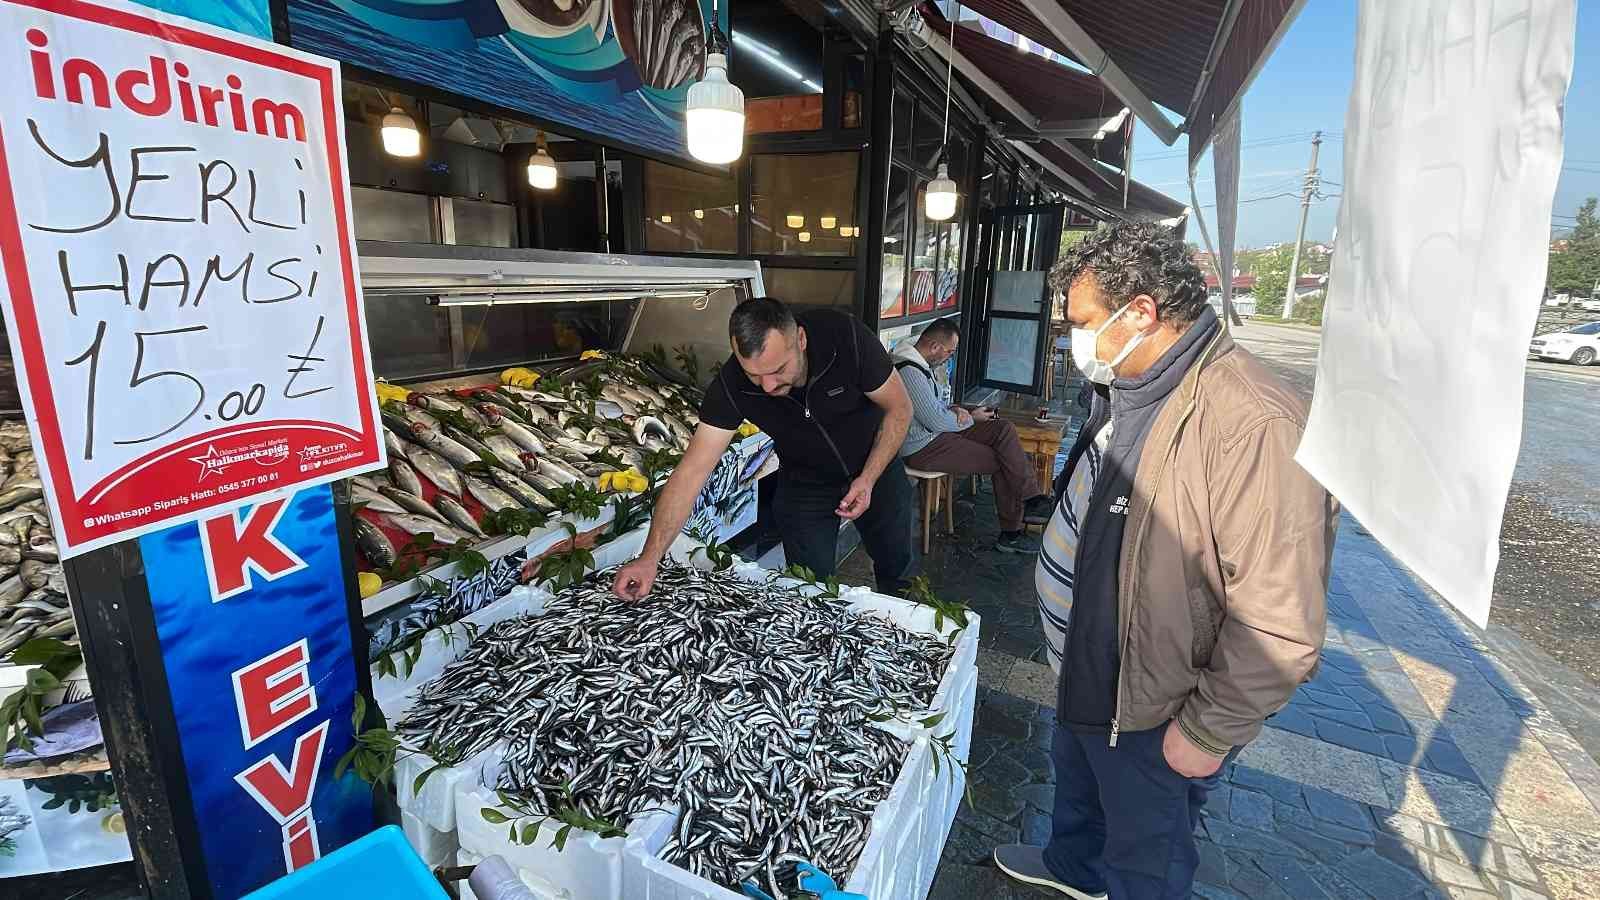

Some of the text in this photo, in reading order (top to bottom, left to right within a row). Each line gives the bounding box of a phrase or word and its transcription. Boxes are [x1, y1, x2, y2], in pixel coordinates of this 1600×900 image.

[26, 28, 307, 143] indirim
[94, 505, 152, 525] Whatsapp
[153, 495, 189, 511] Sipariş
[240, 477, 256, 488] 377
